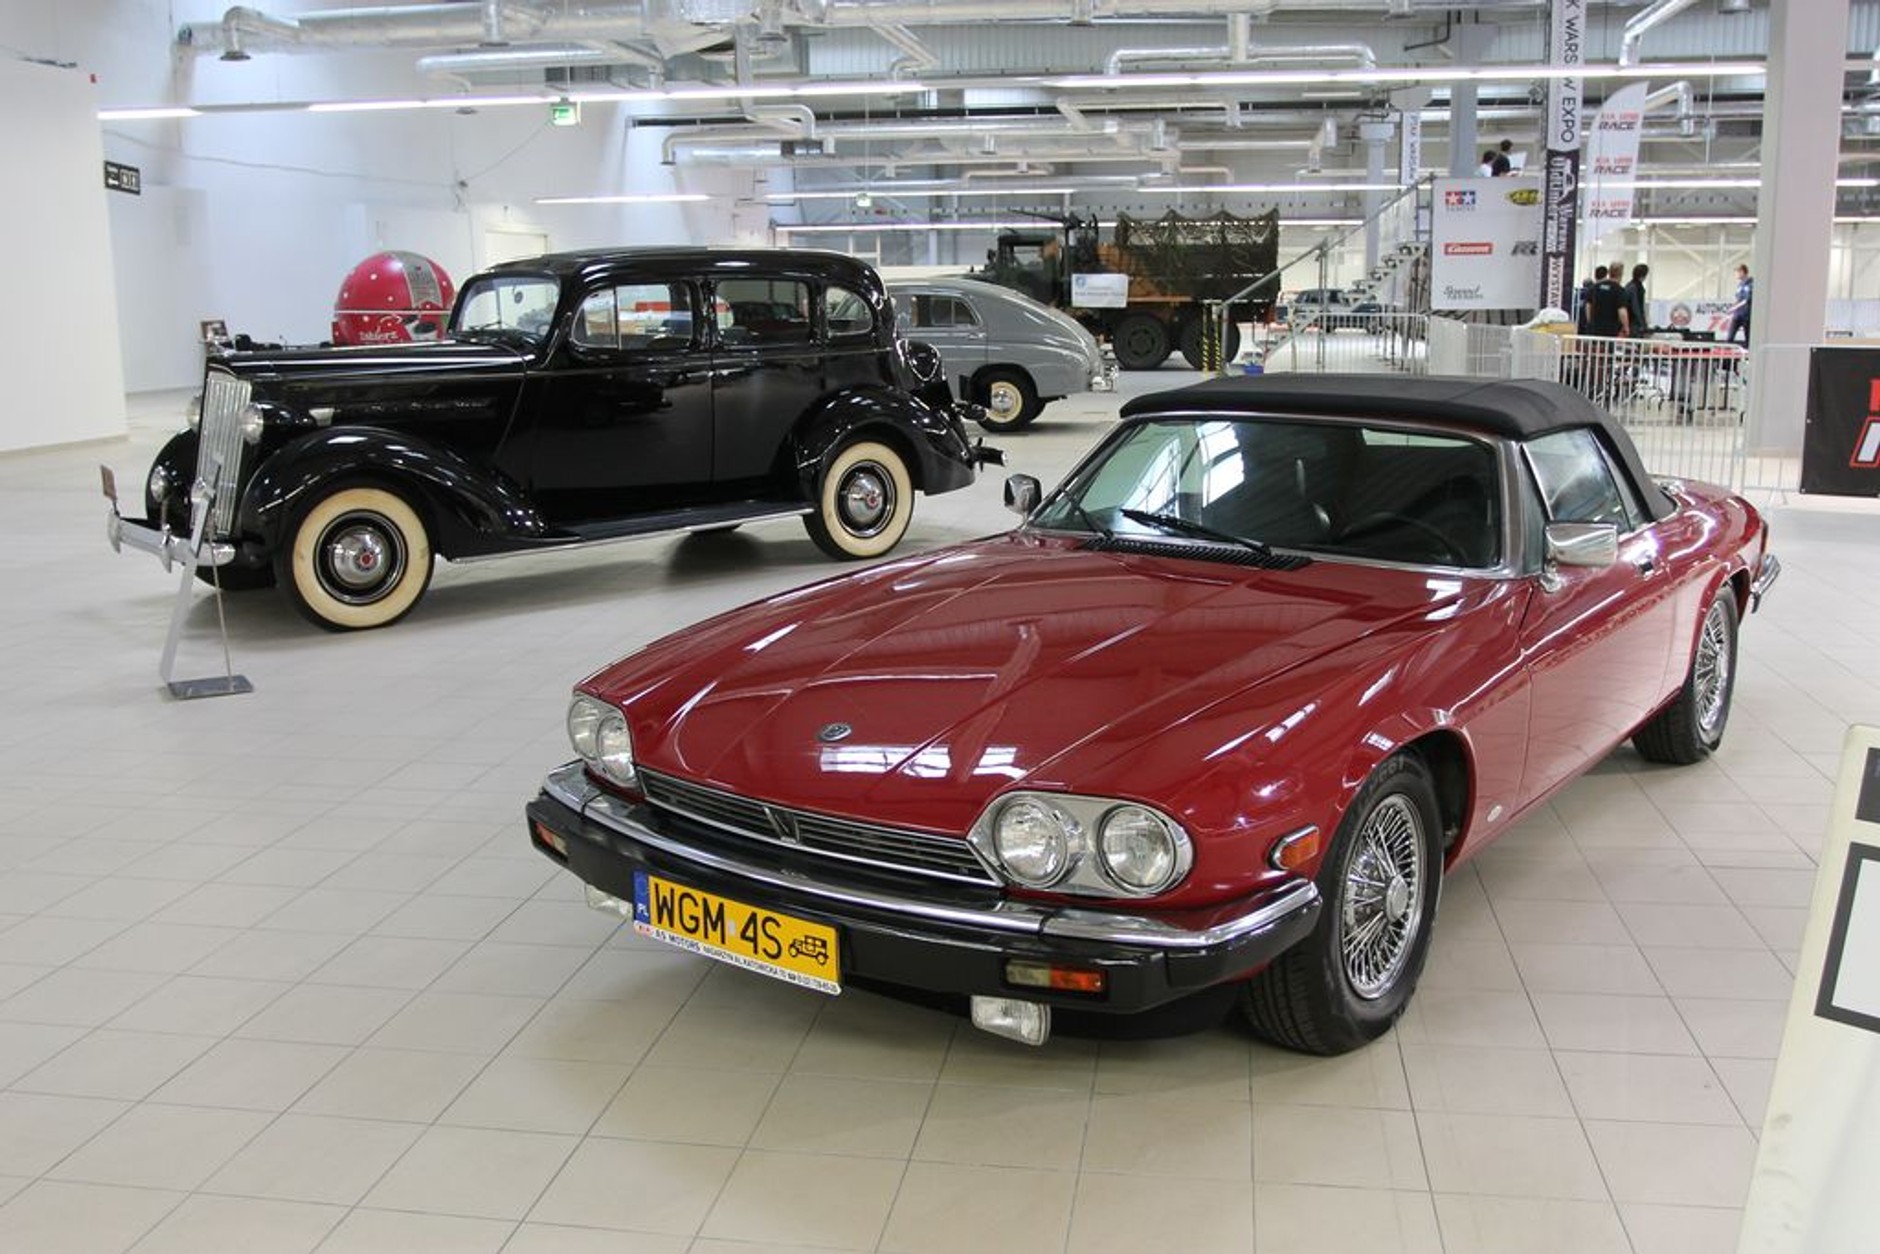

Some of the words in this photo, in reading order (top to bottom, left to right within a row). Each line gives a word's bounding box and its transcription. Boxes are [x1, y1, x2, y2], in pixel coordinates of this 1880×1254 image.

[1563, 16, 1579, 91] WARSW
[1561, 97, 1576, 143] EXPO
[1599, 121, 1636, 130] RACE
[1593, 165, 1630, 174] RACE
[1589, 209, 1628, 218] RACE
[636, 902, 649, 917] PL
[654, 883, 726, 945] WGM
[740, 911, 783, 960] 4S
[668, 933, 700, 951] MOTORS
